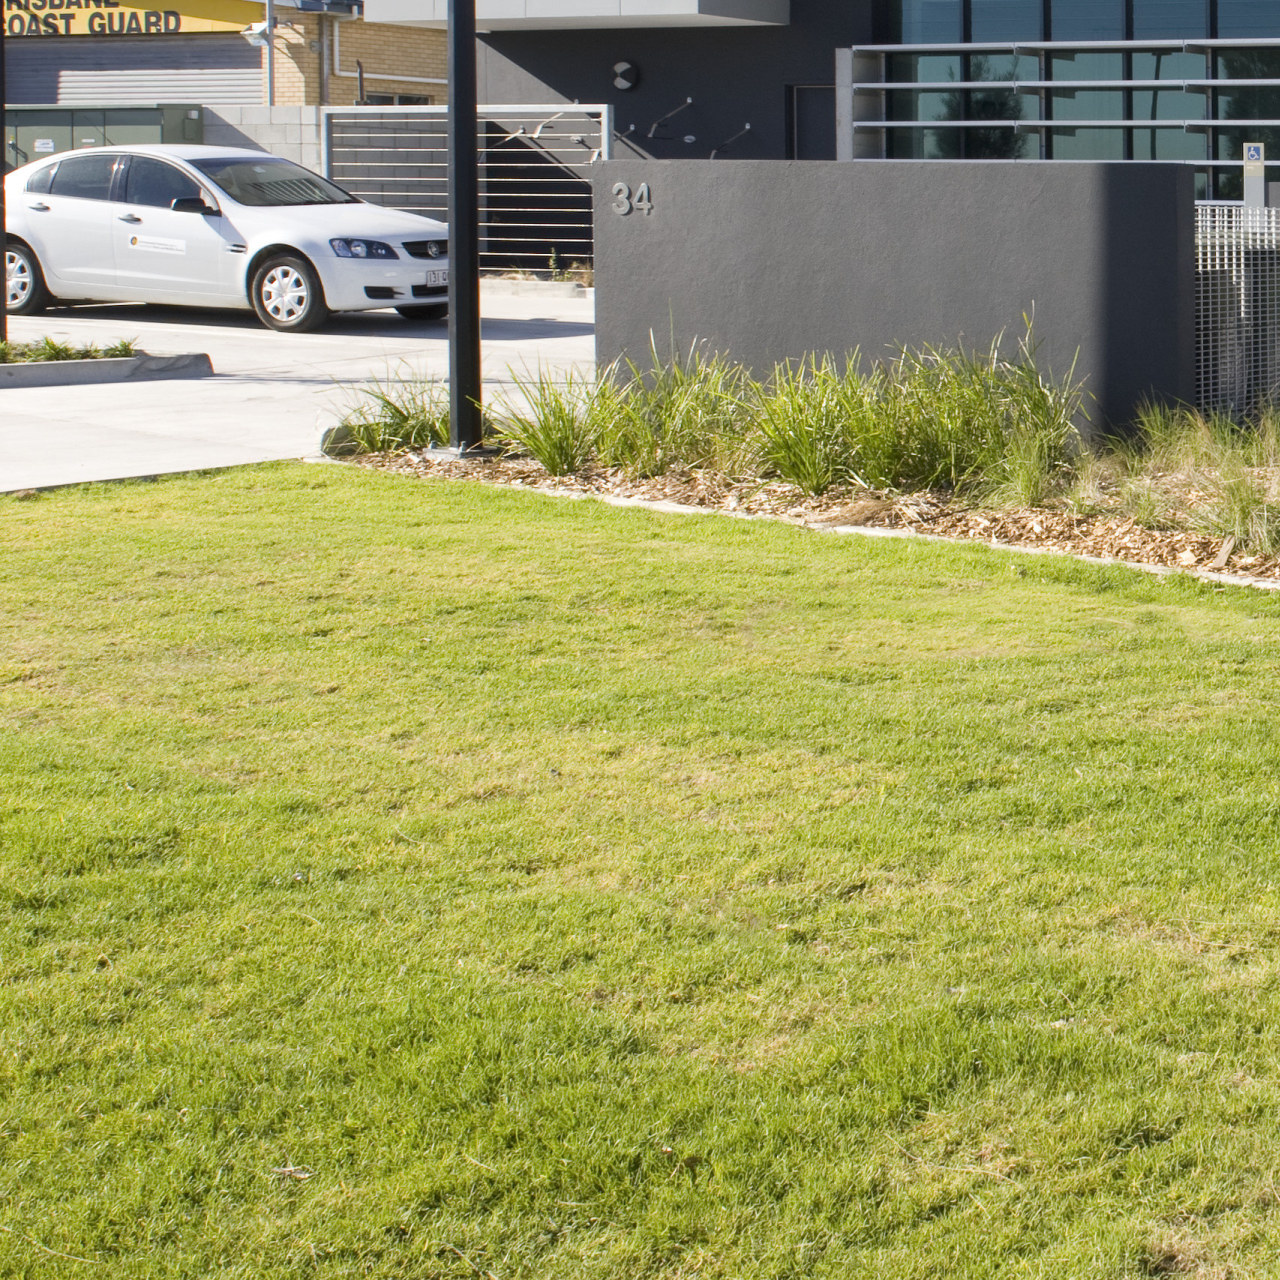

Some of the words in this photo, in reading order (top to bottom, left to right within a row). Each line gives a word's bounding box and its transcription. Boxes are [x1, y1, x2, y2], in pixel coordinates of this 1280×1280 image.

[2, 13, 75, 35] OAST
[88, 11, 181, 34] GUARD
[612, 182, 652, 216] 34
